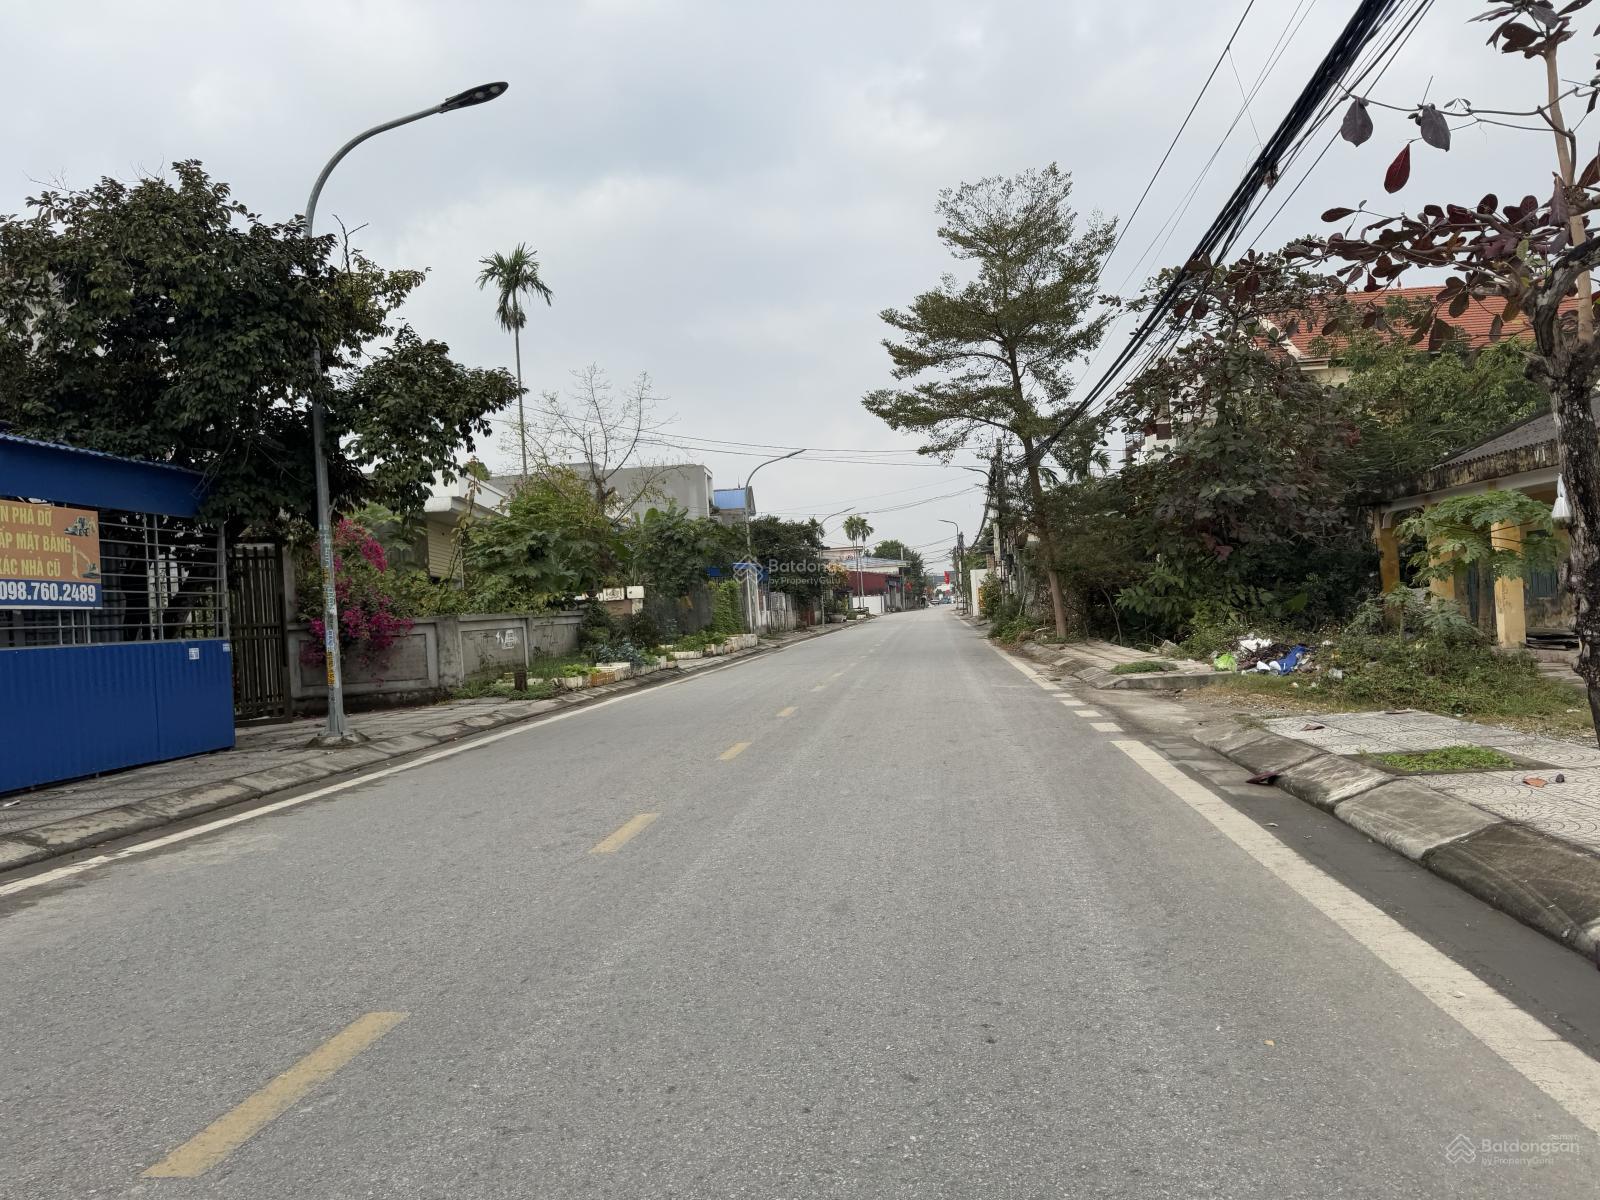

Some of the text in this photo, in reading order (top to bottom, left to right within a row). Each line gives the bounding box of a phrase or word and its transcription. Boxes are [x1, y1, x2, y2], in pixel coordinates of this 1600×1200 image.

[12, 504, 35, 525] PHÁ
[16, 530, 40, 554] MẶT
[42, 530, 72, 553] BẰNG
[21, 556, 46, 577] NHÀ
[46, 558, 61, 577] CŨ
[0, 581, 96, 602] 098.760.2489
